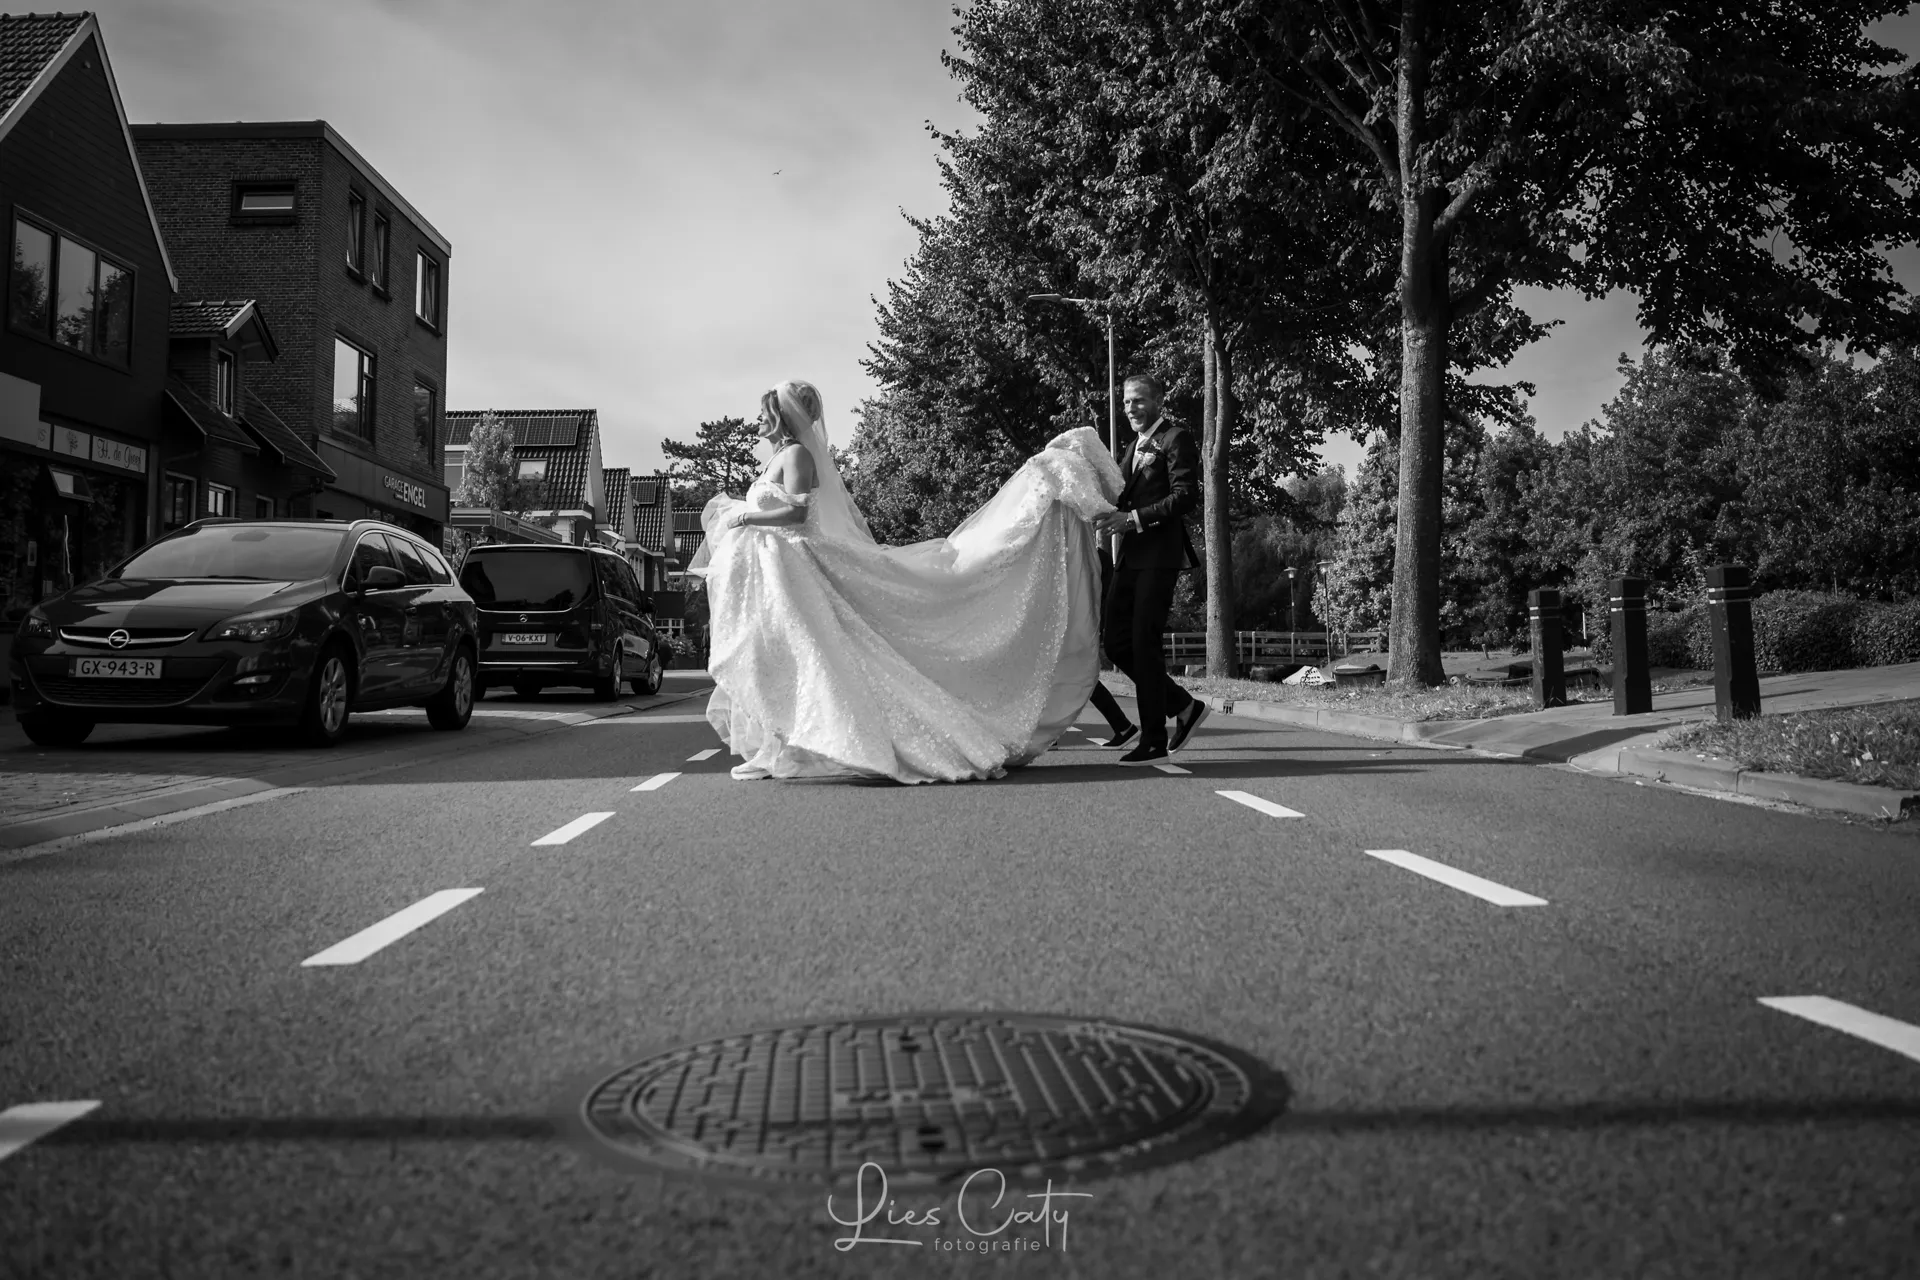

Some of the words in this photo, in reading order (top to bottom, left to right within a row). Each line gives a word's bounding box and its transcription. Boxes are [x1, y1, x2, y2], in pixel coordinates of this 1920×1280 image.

[97, 438, 111, 460] H.
[113, 443, 122, 462] de
[384, 475, 404, 493] GARAGE
[403, 482, 426, 508] ENGEL
[508, 634, 545, 642] V-06-KXT
[81, 660, 155, 676] GX-943-R
